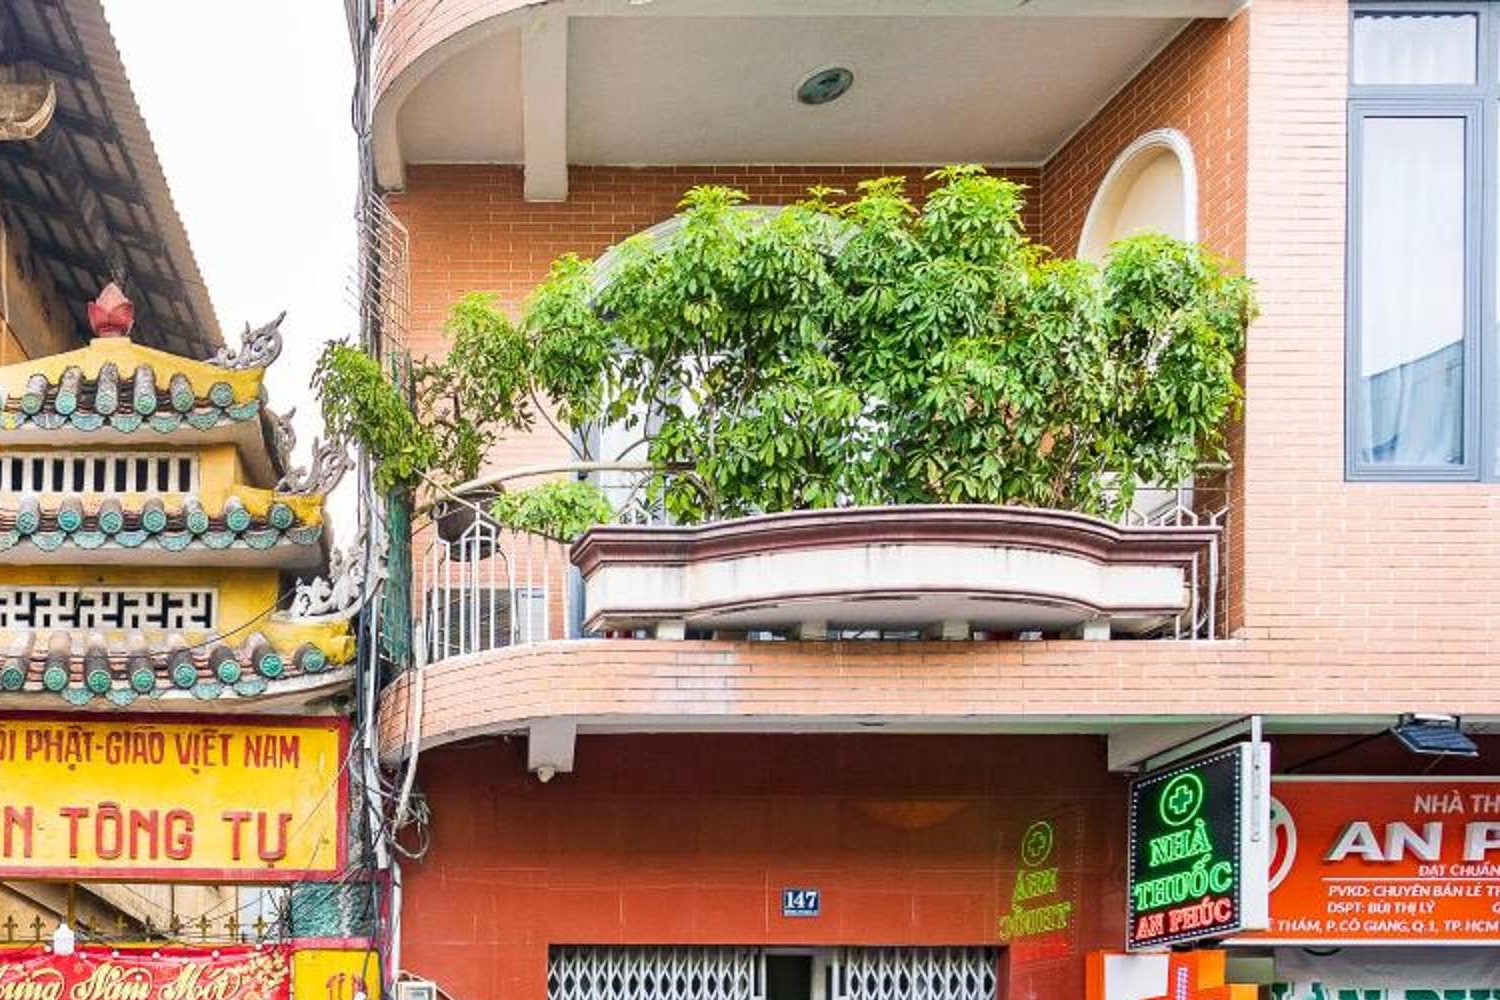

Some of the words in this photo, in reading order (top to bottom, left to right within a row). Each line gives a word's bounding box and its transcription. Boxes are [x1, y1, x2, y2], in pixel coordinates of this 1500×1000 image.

[175, 728, 233, 774] VIỆT
[243, 734, 300, 769] NAM
[1414, 789, 1465, 814] NHÀ
[60, 801, 194, 861] TÔNG
[222, 811, 293, 869] TỰ
[1324, 821, 1444, 862] AN
[787, 891, 817, 909] 147
[1134, 853, 1233, 912] THUỐC
[1328, 885, 1370, 898] PVKD:
[1373, 882, 1432, 898] CHUYÊN
[1136, 912, 1165, 941] AN
[1169, 895, 1232, 933] PHÚC
